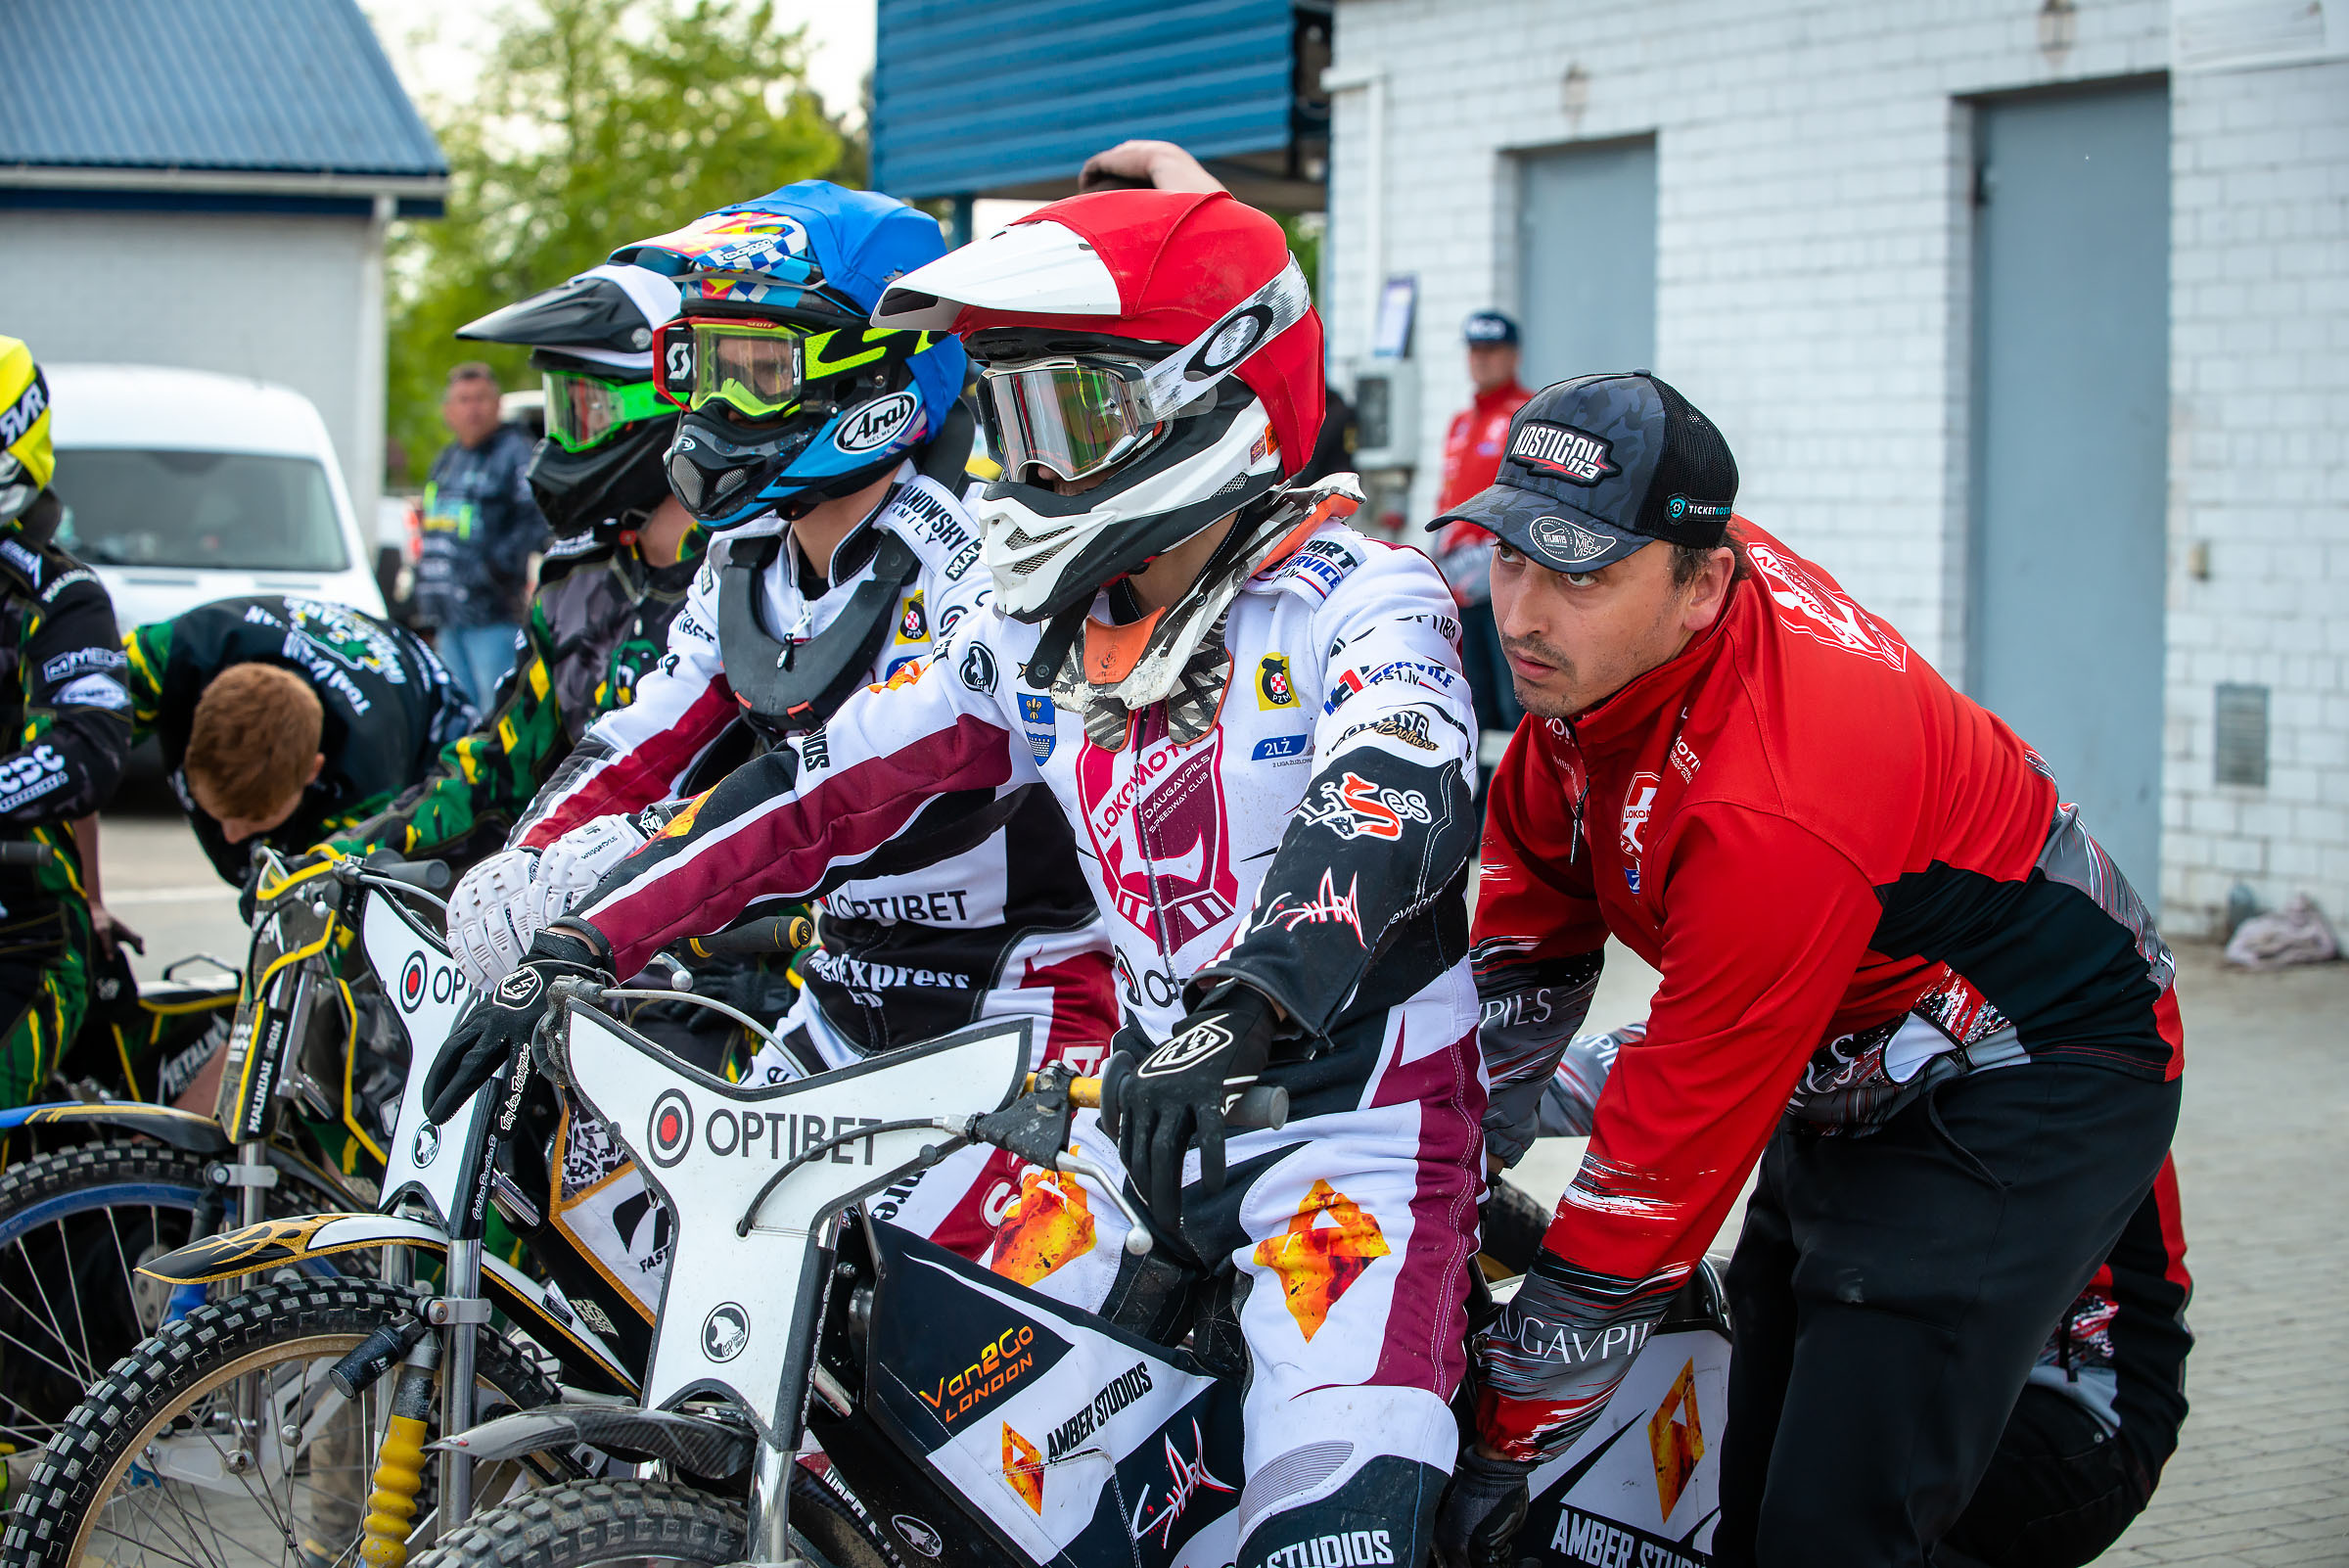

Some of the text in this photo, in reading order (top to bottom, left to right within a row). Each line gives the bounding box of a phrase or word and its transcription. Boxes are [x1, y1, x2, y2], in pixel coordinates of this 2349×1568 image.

[847, 396, 910, 447] Arai
[1510, 426, 1604, 467] KOSTIGOV
[1567, 457, 1600, 480] 113
[1572, 528, 1595, 543] NEW
[1573, 545, 1601, 557] VISOR
[1575, 539, 1594, 548] MID
[1272, 692, 1292, 703] PZM
[1264, 737, 1292, 757] 2LŻ
[1144, 754, 1211, 819] DAUGAVPILS
[1148, 771, 1209, 834] SPEEDWAY CLUB
[836, 890, 967, 922] OPTIBET
[499, 1042, 531, 1131] Troy Lee Designs
[706, 1108, 883, 1166] OPTIBET
[918, 1325, 1035, 1408] Van2Go
[944, 1353, 1034, 1423] LONDON
[1046, 1360, 1154, 1463] AMBER STUDIOS
[1549, 1508, 1635, 1568] AMBER
